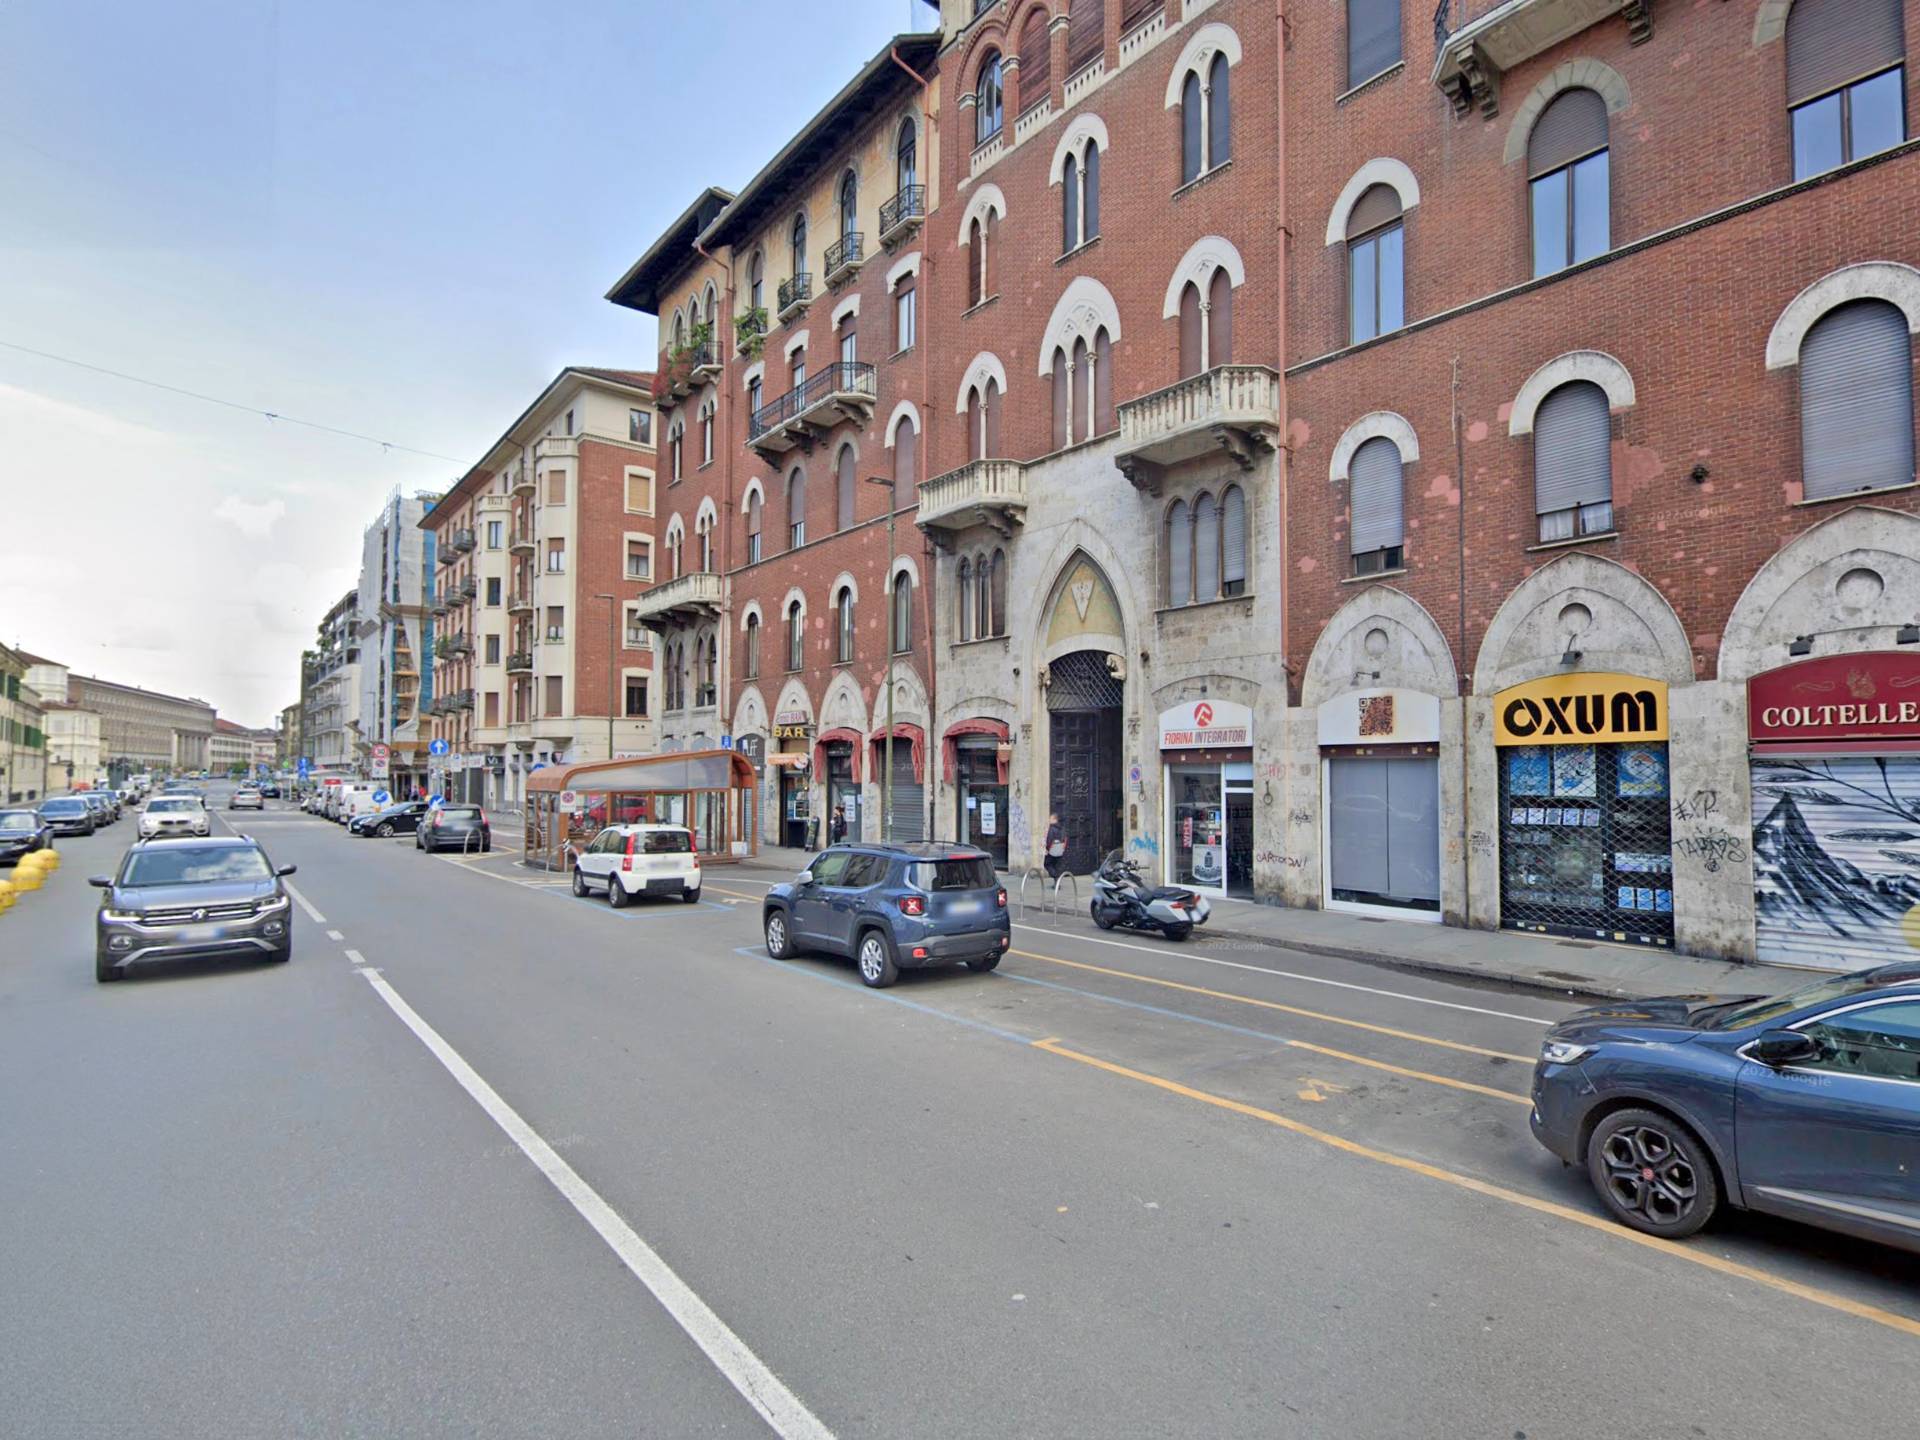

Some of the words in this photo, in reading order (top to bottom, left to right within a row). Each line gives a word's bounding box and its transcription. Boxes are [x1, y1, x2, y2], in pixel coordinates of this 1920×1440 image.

[1762, 702, 1919, 728] COLTELLE
[773, 725, 804, 737] BAR
[1164, 731, 1193, 745] FIORINA
[1195, 729, 1246, 744] INTEGRATORI
